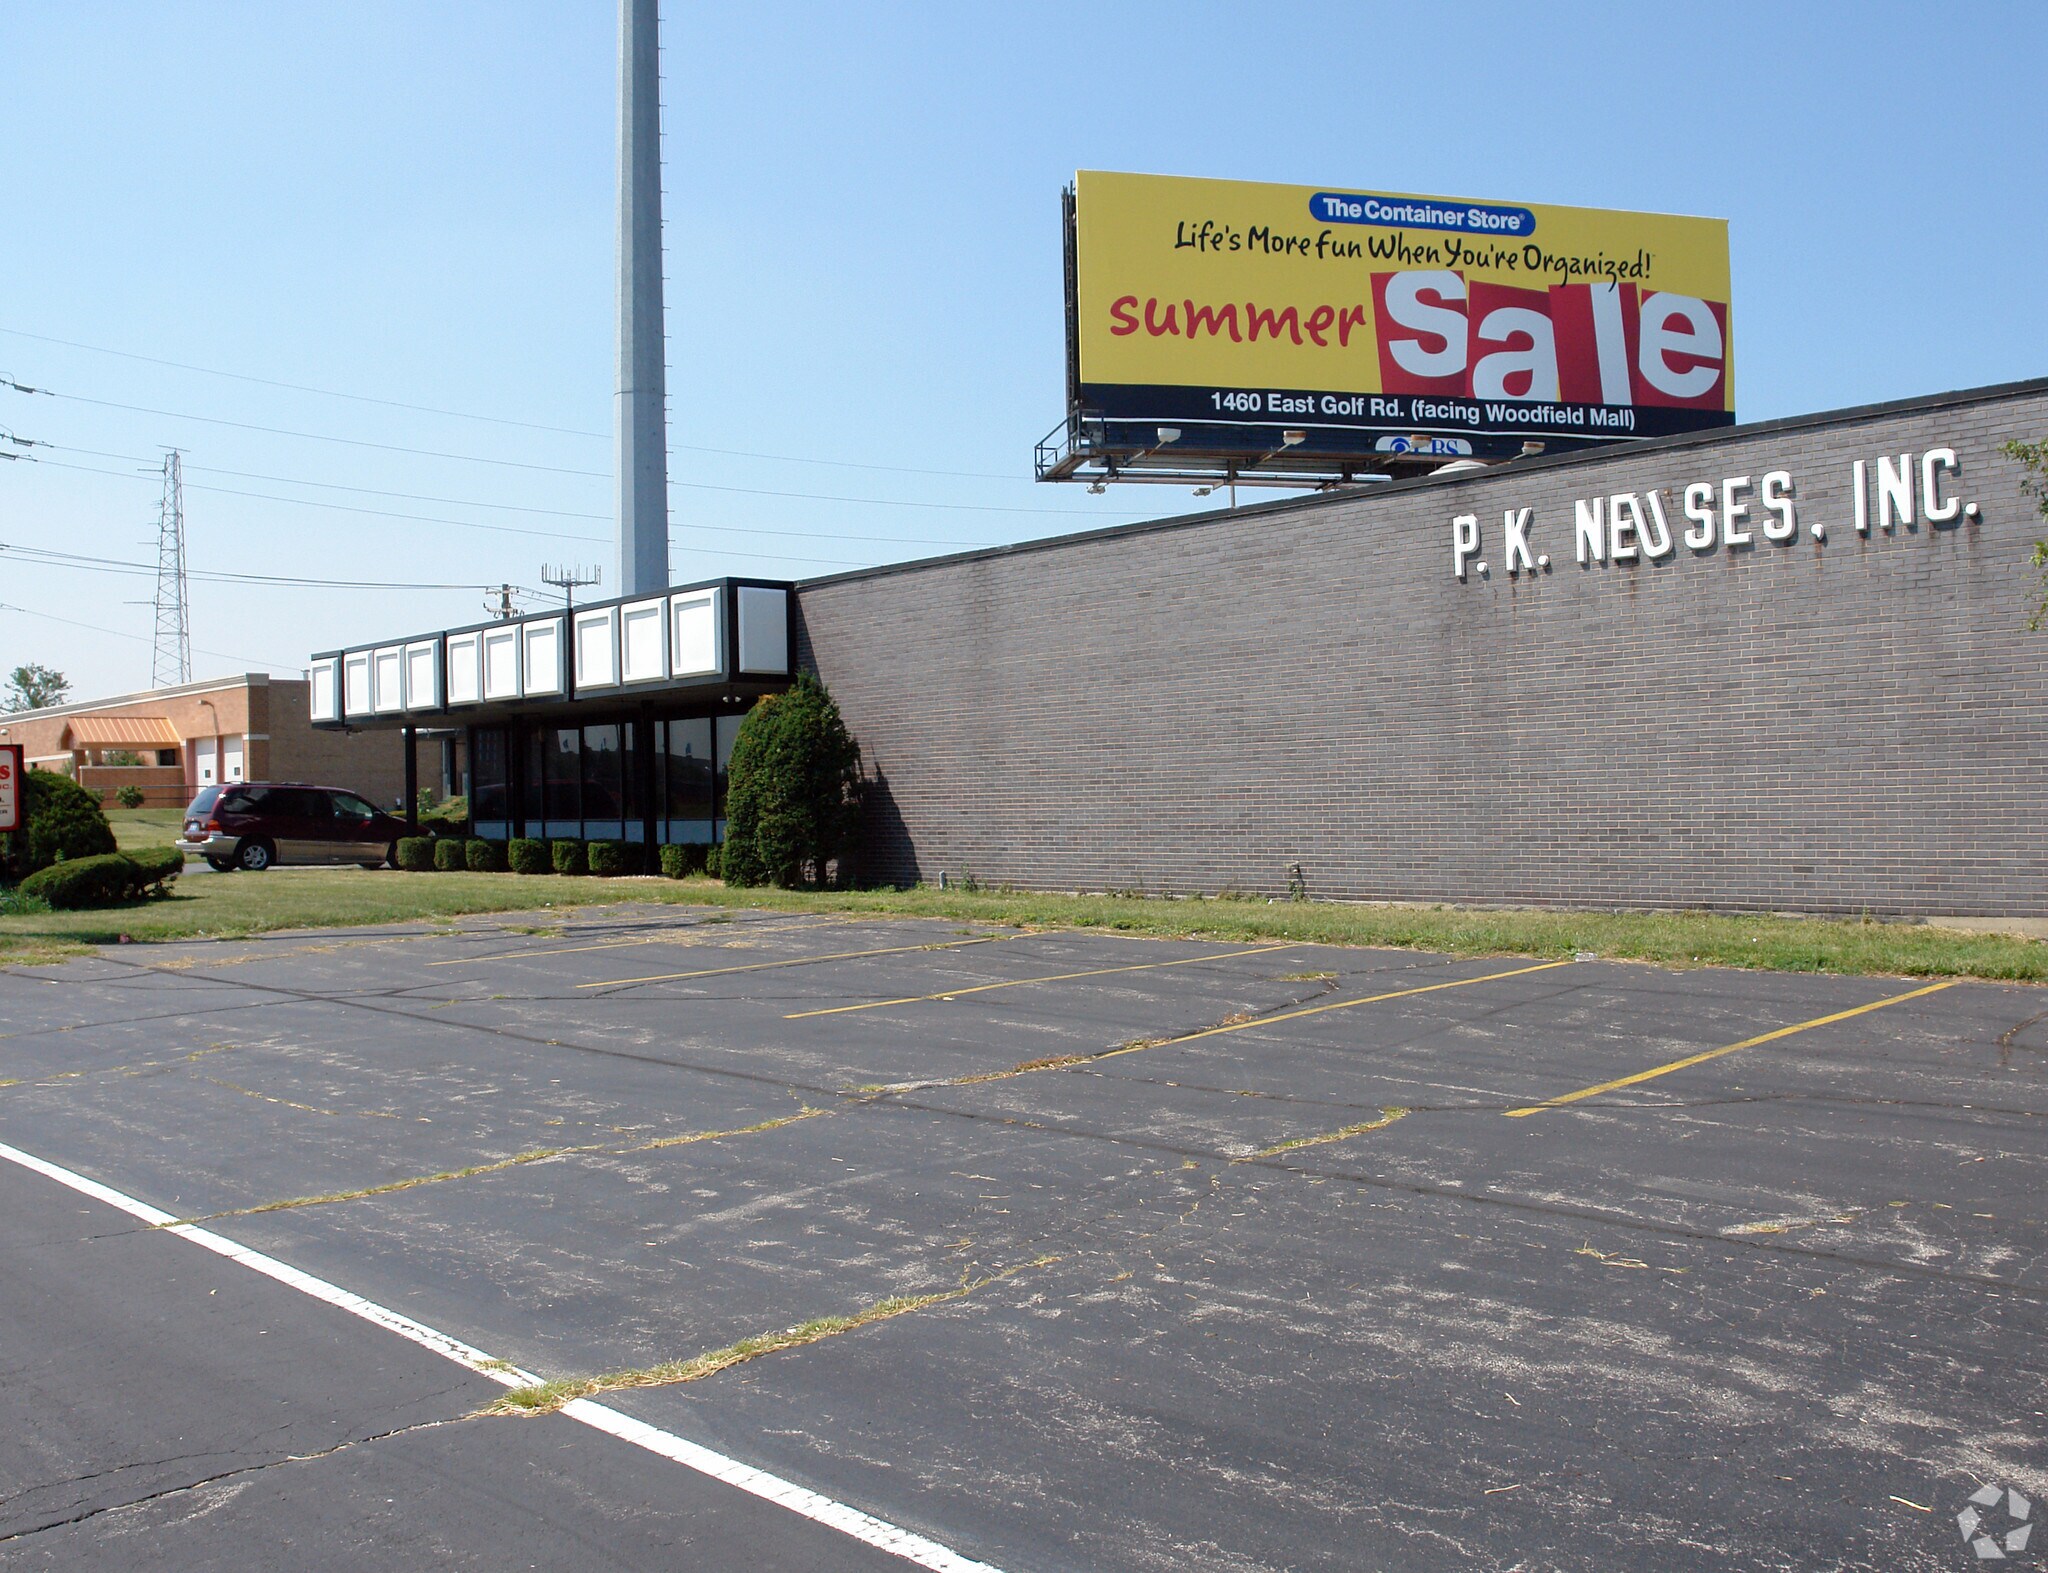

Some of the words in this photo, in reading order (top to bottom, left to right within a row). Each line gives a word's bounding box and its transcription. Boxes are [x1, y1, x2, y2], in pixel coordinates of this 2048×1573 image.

[1323, 197, 1362, 218] The
[1364, 200, 1465, 226] Container
[1174, 220, 1241, 252] Life's
[1248, 225, 1311, 256] More
[1368, 231, 1440, 265] When
[1444, 238, 1518, 270] You're
[1523, 244, 1651, 292] Organized!
[1109, 294, 1367, 348] summer
[1385, 270, 1723, 405] Sale
[1211, 391, 1262, 411] 1460
[1268, 393, 1315, 413] East
[1320, 395, 1364, 415] Golf
[1370, 398, 1405, 417] Rd.
[1411, 399, 1480, 424] (facing
[1485, 404, 1584, 425] Woodfield
[1590, 408, 1635, 430] Mall)
[1453, 514, 1489, 577] P.
[1504, 506, 1550, 572] K.
[1854, 447, 1980, 531] INC.
